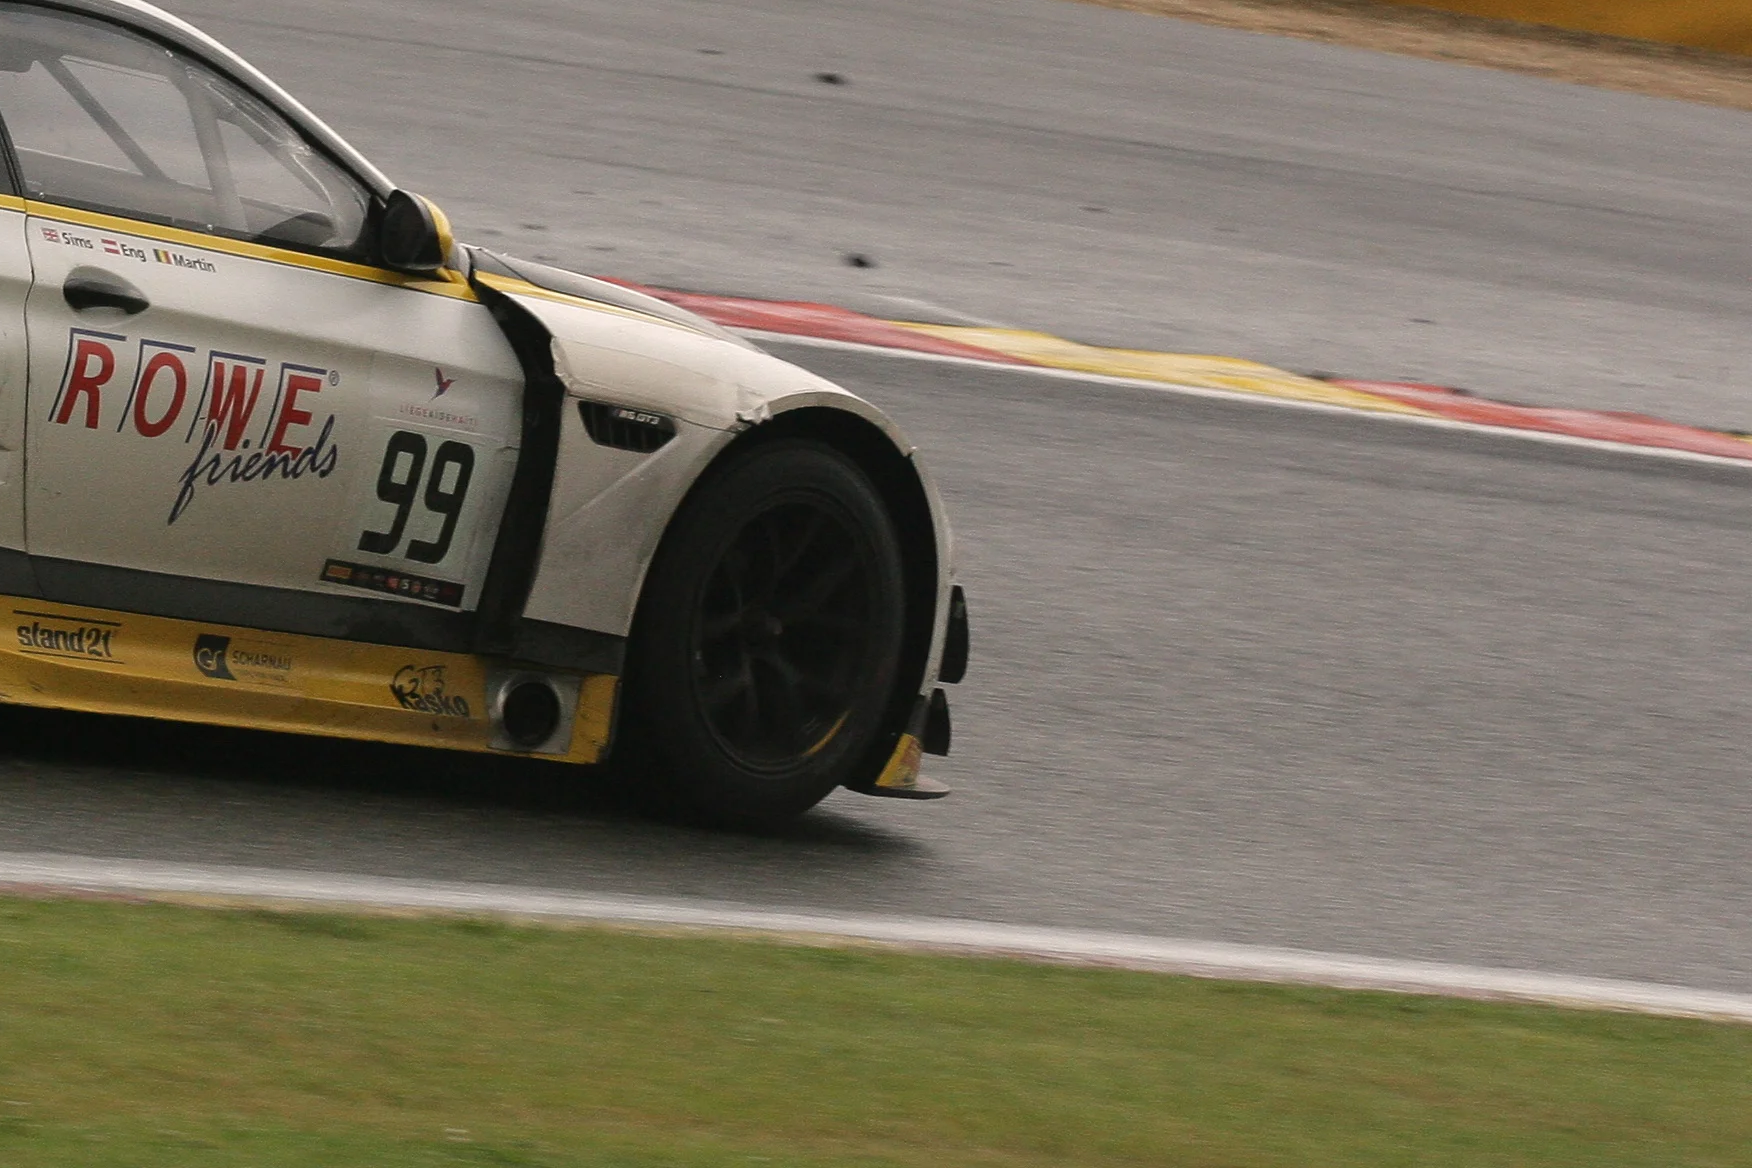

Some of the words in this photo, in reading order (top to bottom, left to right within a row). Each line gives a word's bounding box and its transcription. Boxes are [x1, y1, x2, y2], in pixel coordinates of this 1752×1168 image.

[61, 231, 95, 250] Sims
[121, 243, 147, 263] Eng
[172, 252, 217, 274] Martin
[51, 332, 327, 460] ROWE
[167, 412, 338, 526] friends
[356, 430, 476, 566] 99
[15, 621, 112, 659] stand21
